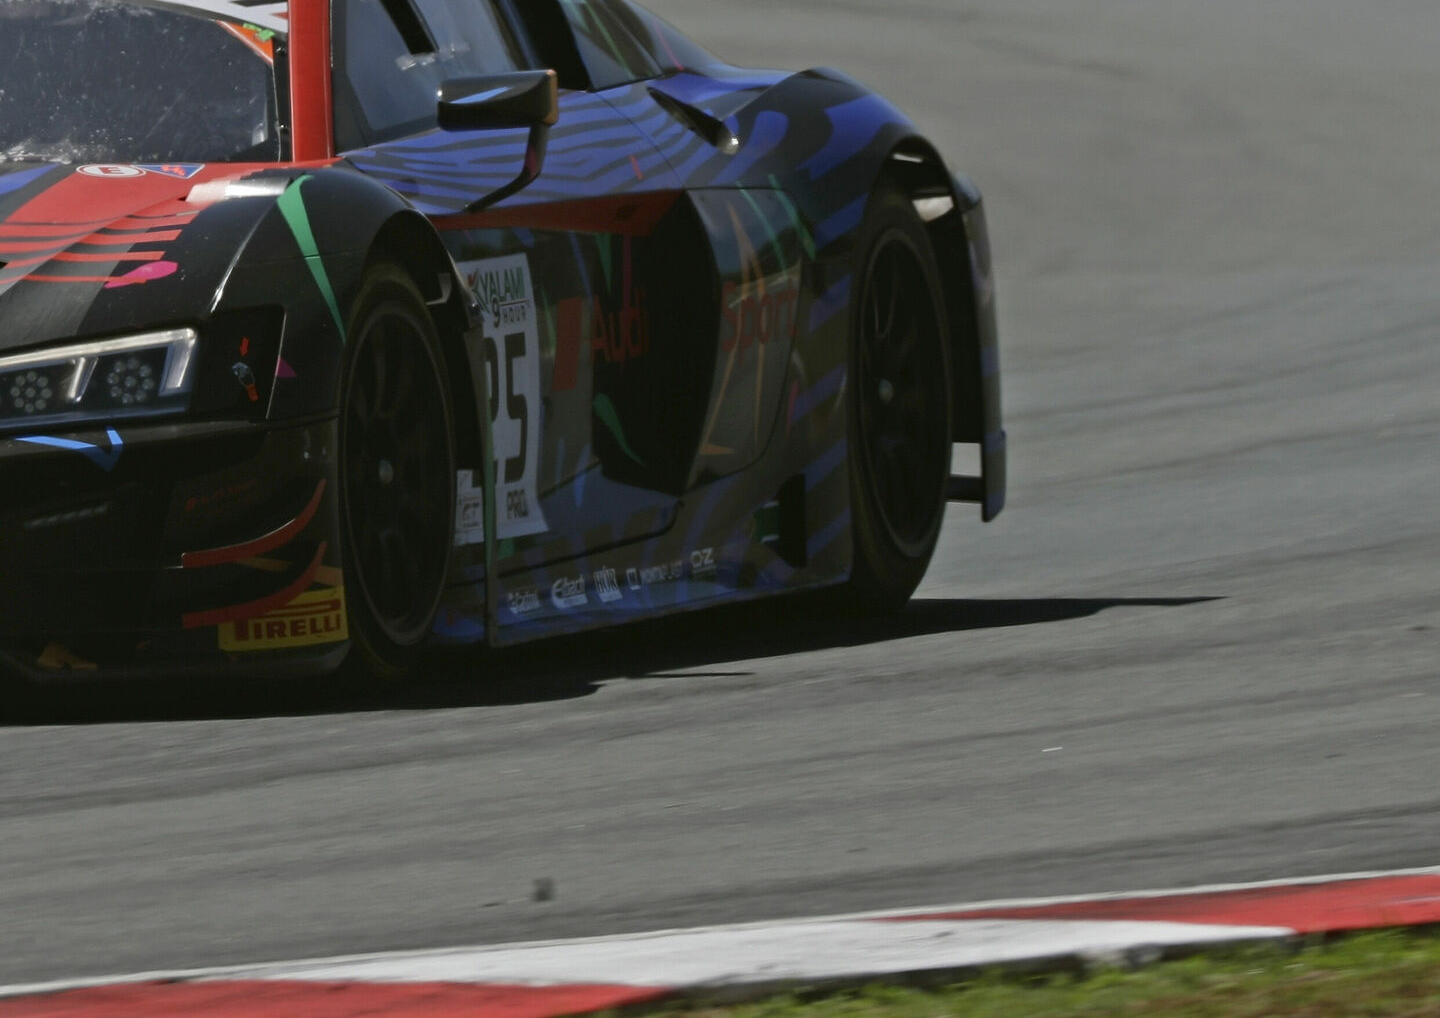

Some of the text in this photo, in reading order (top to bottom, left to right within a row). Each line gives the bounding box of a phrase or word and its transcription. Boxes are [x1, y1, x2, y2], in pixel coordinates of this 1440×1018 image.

[466, 266, 526, 315] KYALAMI
[491, 297, 501, 329] 9
[591, 277, 799, 364] Audi Sport
[506, 488, 529, 519] PRO
[689, 547, 715, 569] OZ
[234, 598, 342, 642] PIRELLI
